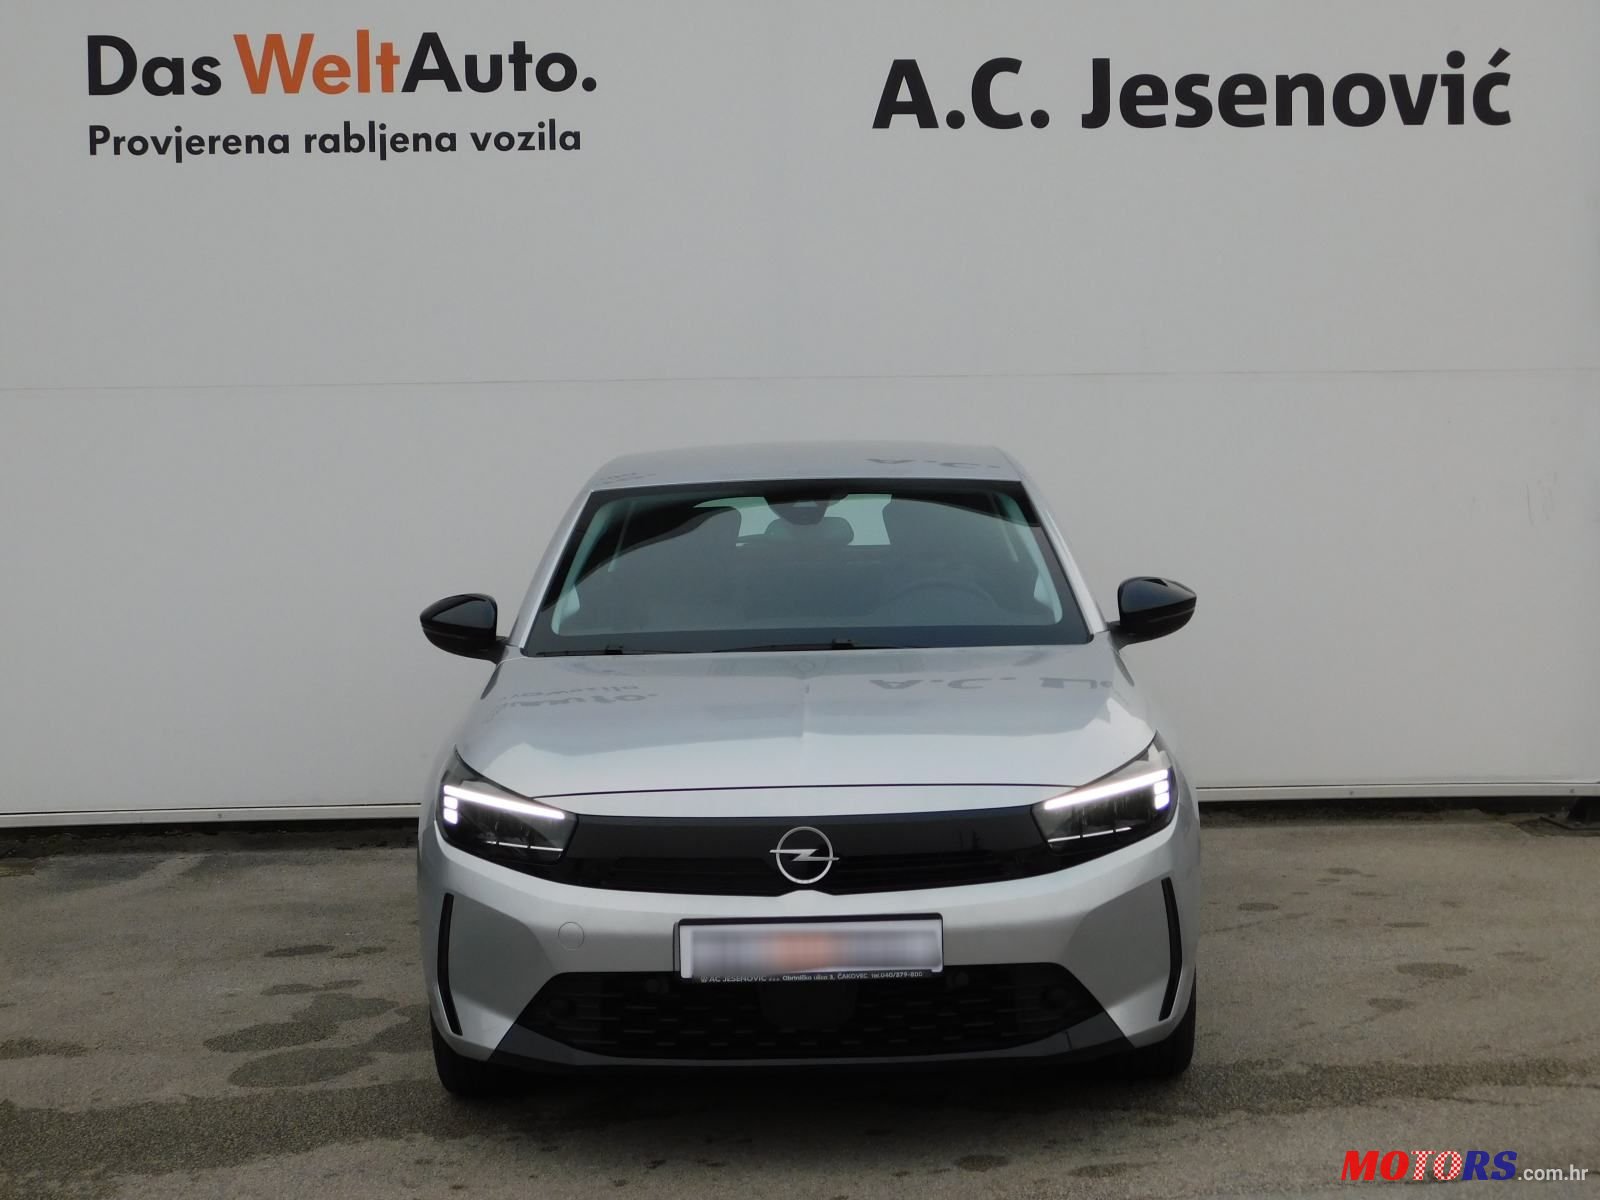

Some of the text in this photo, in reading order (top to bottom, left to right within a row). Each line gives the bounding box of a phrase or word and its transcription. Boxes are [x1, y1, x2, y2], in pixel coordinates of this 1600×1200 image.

[88, 30, 597, 96] Das WeltAuto.
[872, 48, 1512, 129] A.C. Jesenović
[88, 118, 581, 163] Provjerena rabljena vozila
